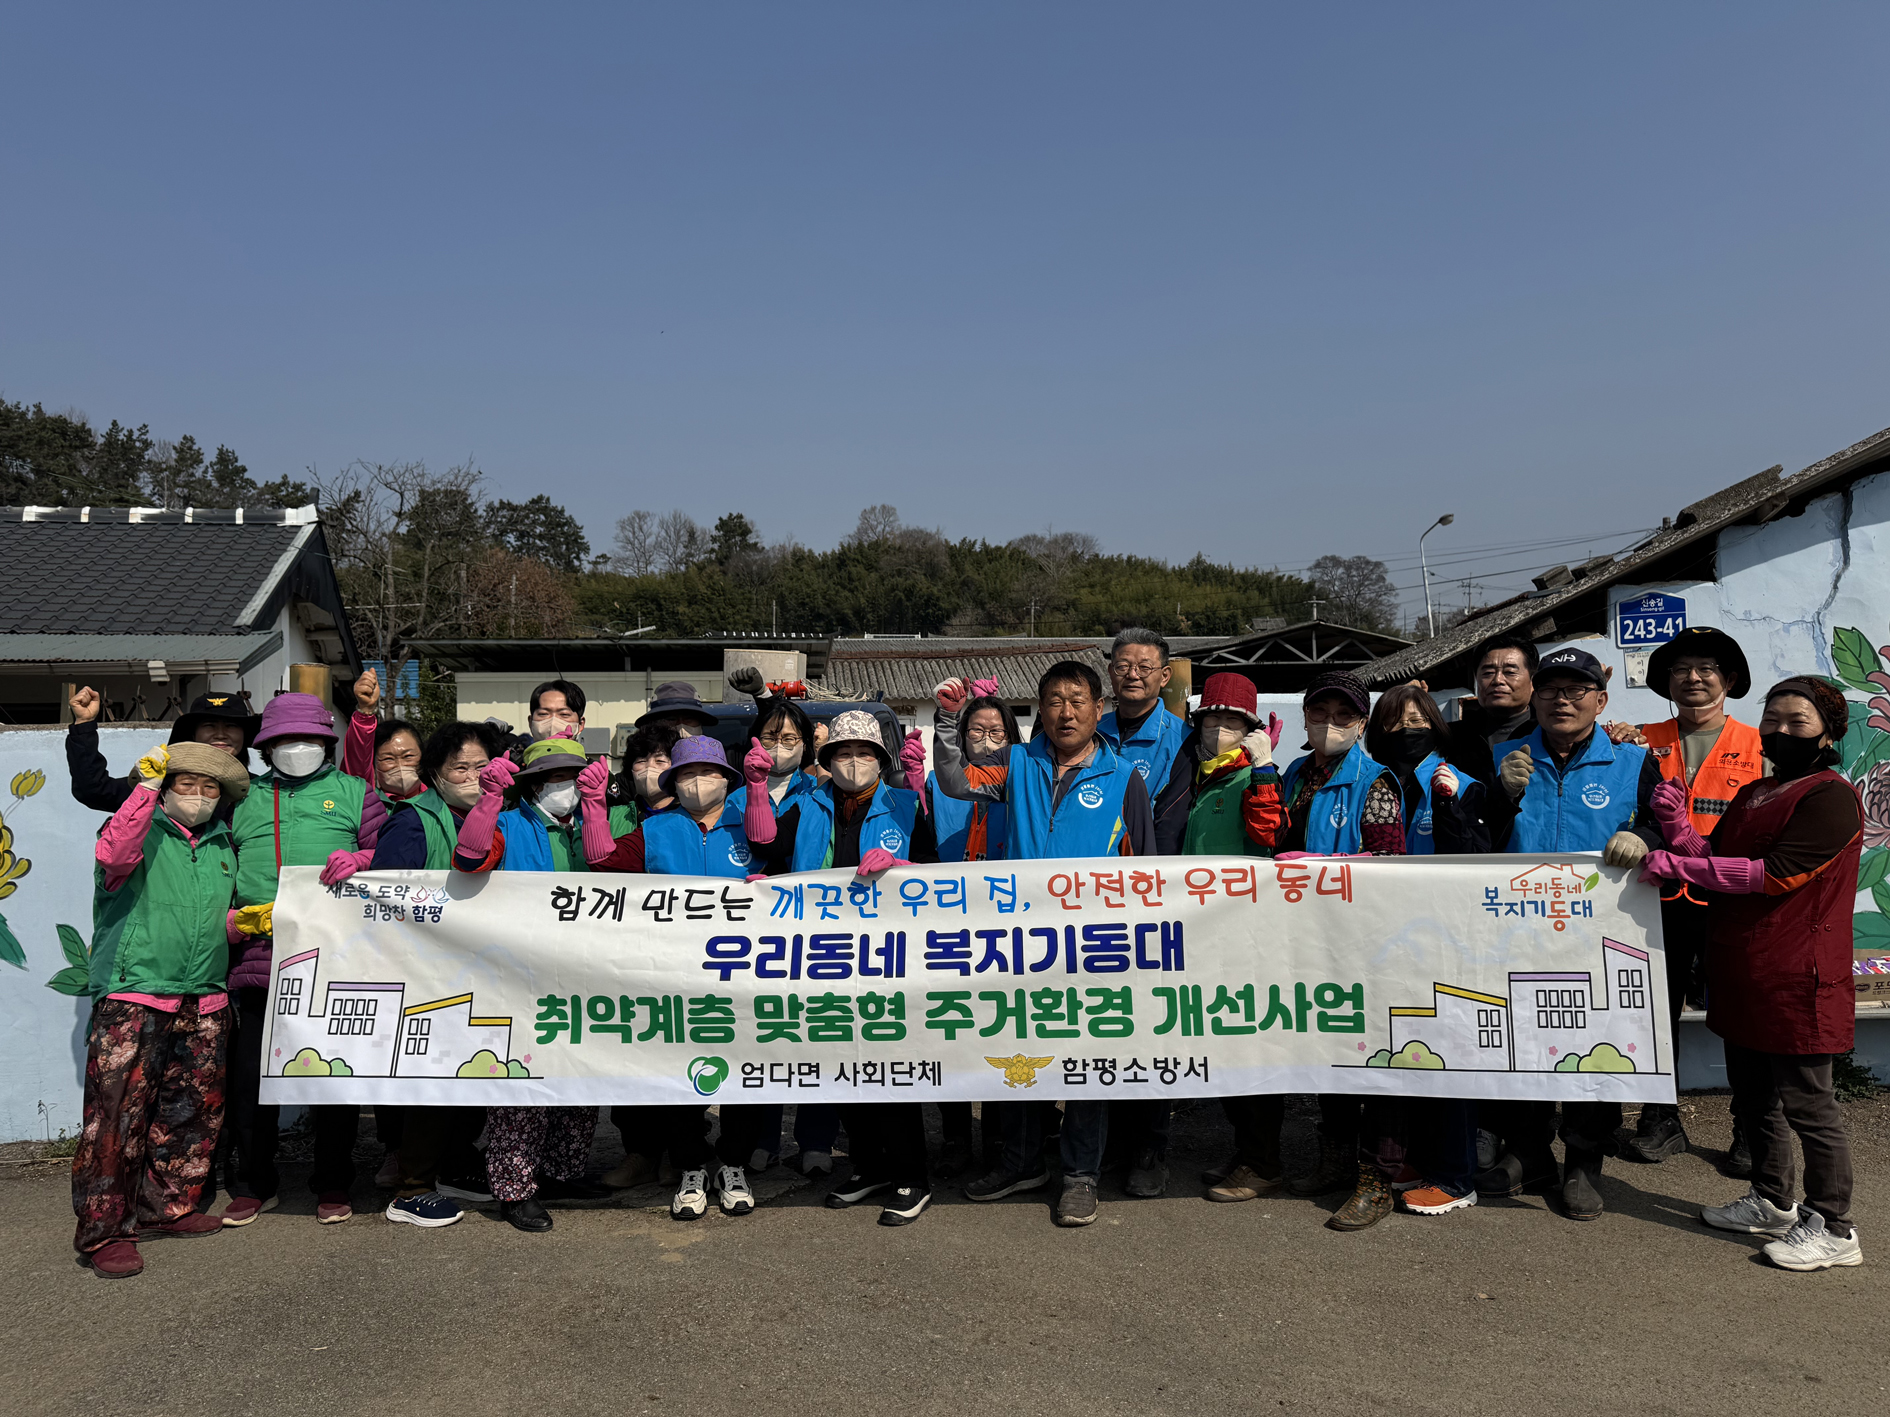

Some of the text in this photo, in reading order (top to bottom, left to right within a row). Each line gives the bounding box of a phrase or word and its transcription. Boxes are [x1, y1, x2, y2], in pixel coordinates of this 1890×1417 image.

[1623, 617, 1683, 639] 243-41
[326, 881, 411, 900] 새로운 도약
[551, 863, 1353, 922] 함께 만드는 깨끗한 우리 집, 안전한 우리 동네
[1517, 877, 1582, 898] 우리동네
[363, 903, 443, 923] 희망찬 함평
[1481, 886, 1593, 932] 복지기동대
[702, 920, 1185, 981] 우리동네 복지기동대
[535, 981, 1365, 1044] 취약계층 맞춤형 주거환경 개선사업
[741, 1059, 942, 1088] 엄다면 사회단체
[1061, 1056, 1209, 1086] 함평소방서
